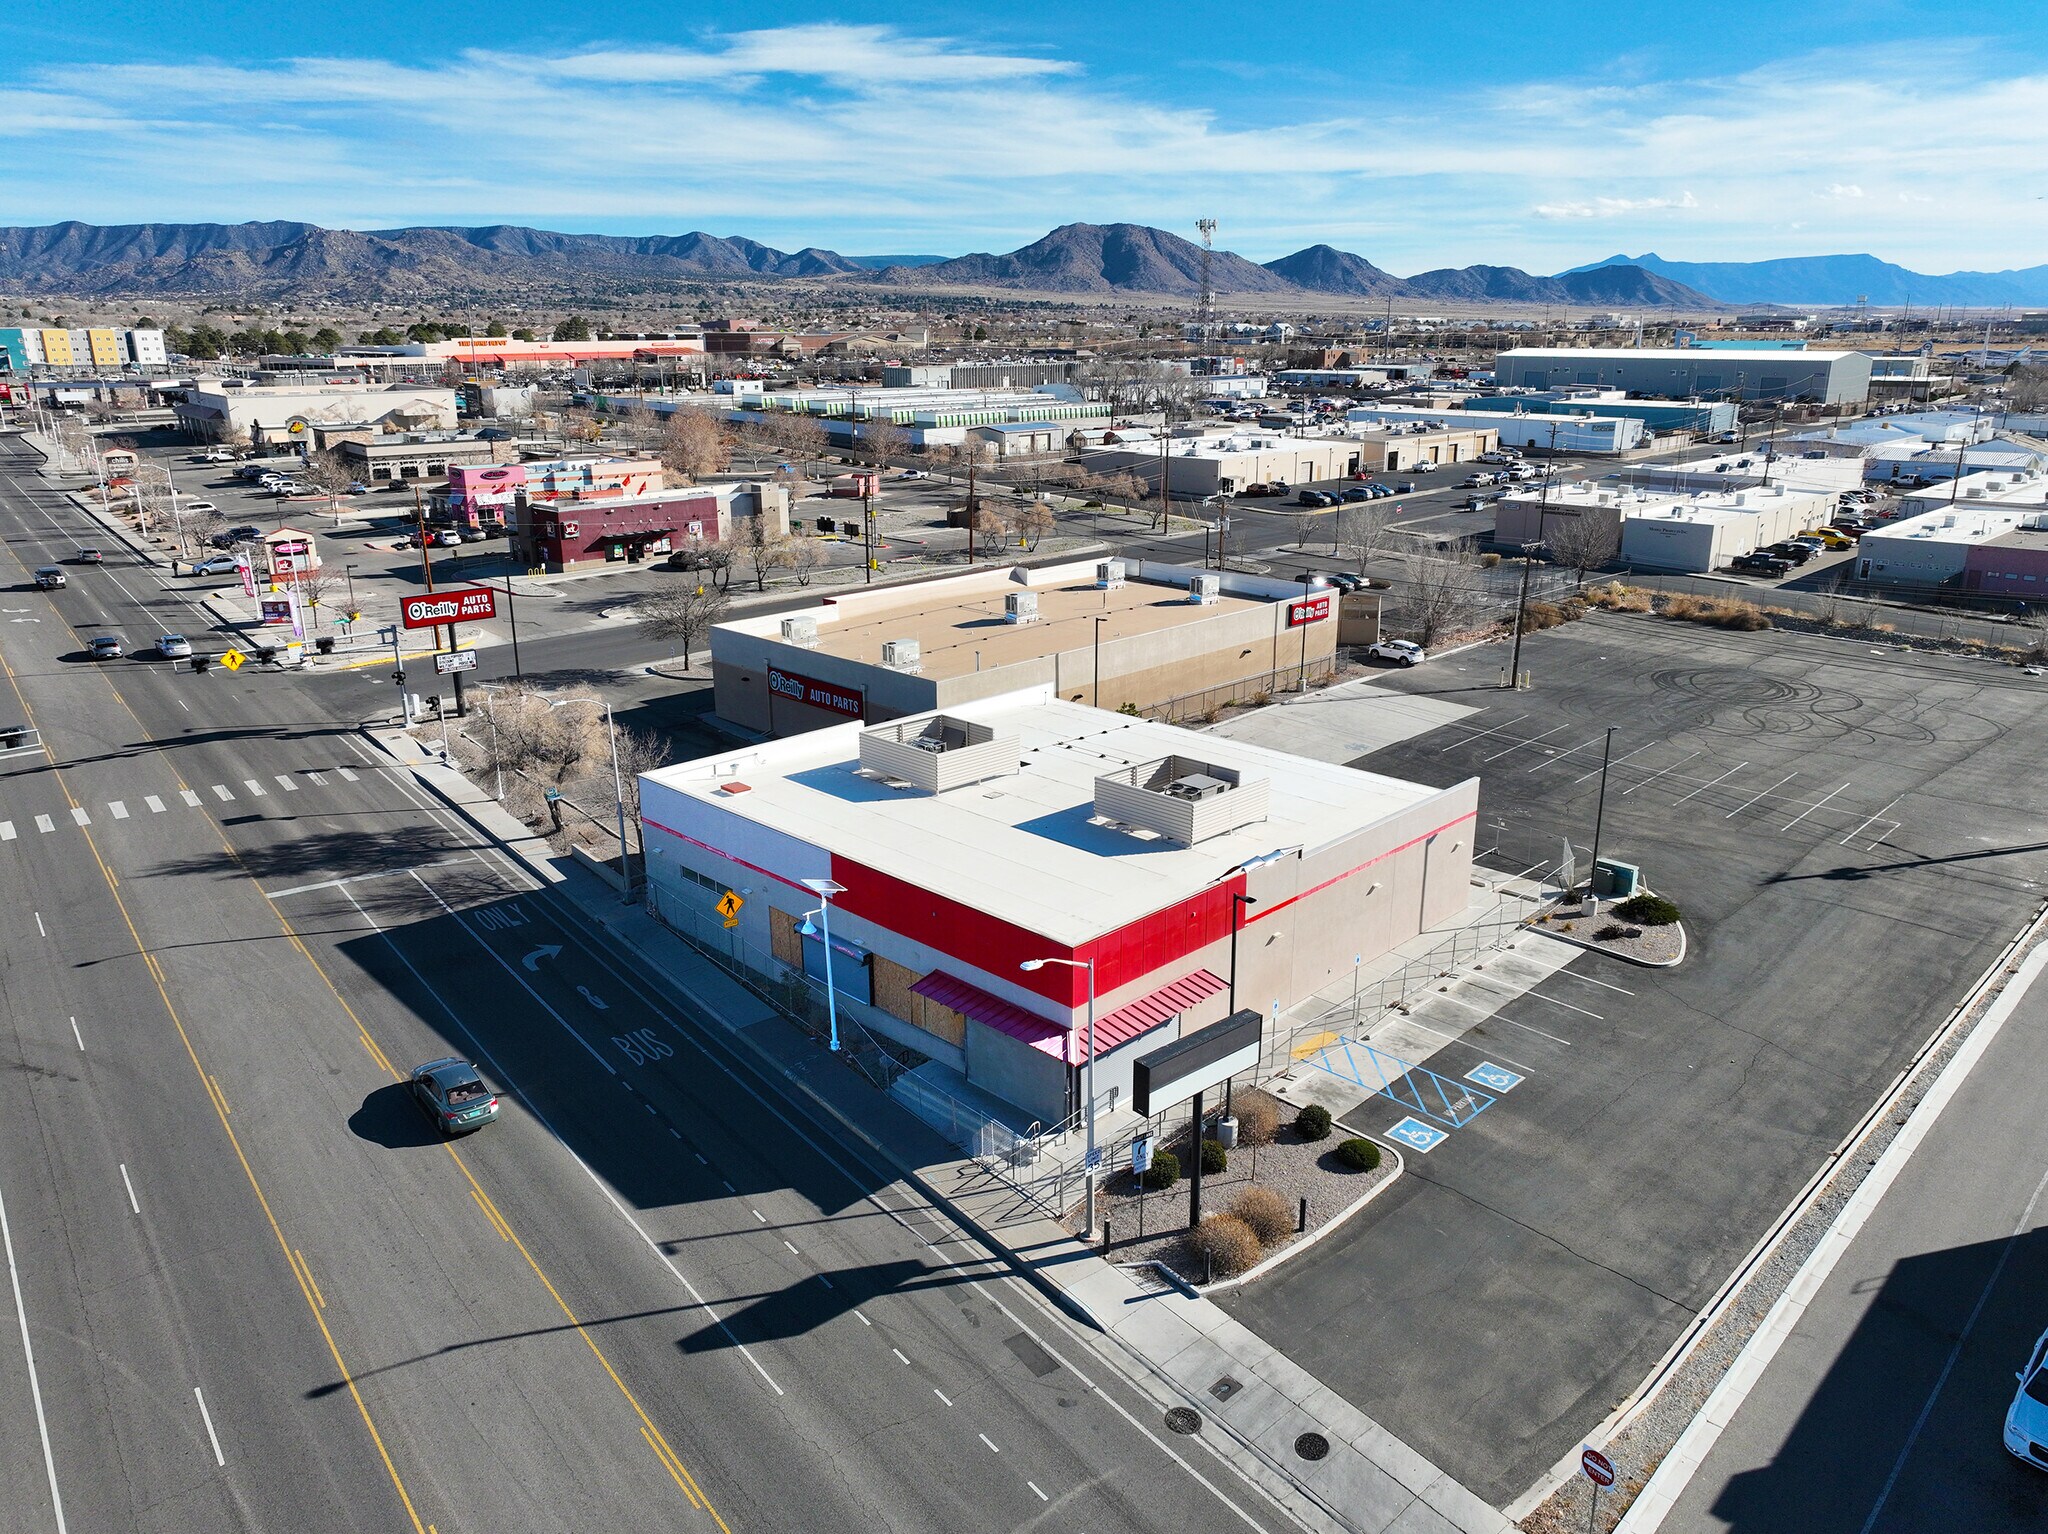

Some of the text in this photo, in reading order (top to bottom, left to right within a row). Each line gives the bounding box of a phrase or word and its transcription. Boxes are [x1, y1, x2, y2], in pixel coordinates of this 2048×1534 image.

[463, 594, 488, 605] AUTO
[409, 602, 491, 620] O'Reilly PARTS
[1315, 608, 1328, 617] PARTS
[769, 671, 859, 713] O'Reilly AUTO PARTS
[474, 903, 531, 930] ONLY
[576, 985, 609, 1009] &
[611, 1027, 674, 1066] BUS
[1136, 1151, 1150, 1161] ONLY
[1088, 1160, 1101, 1172] 35
[1587, 1452, 1613, 1472] DO NOT
[1587, 1466, 1610, 1485] ENTER
